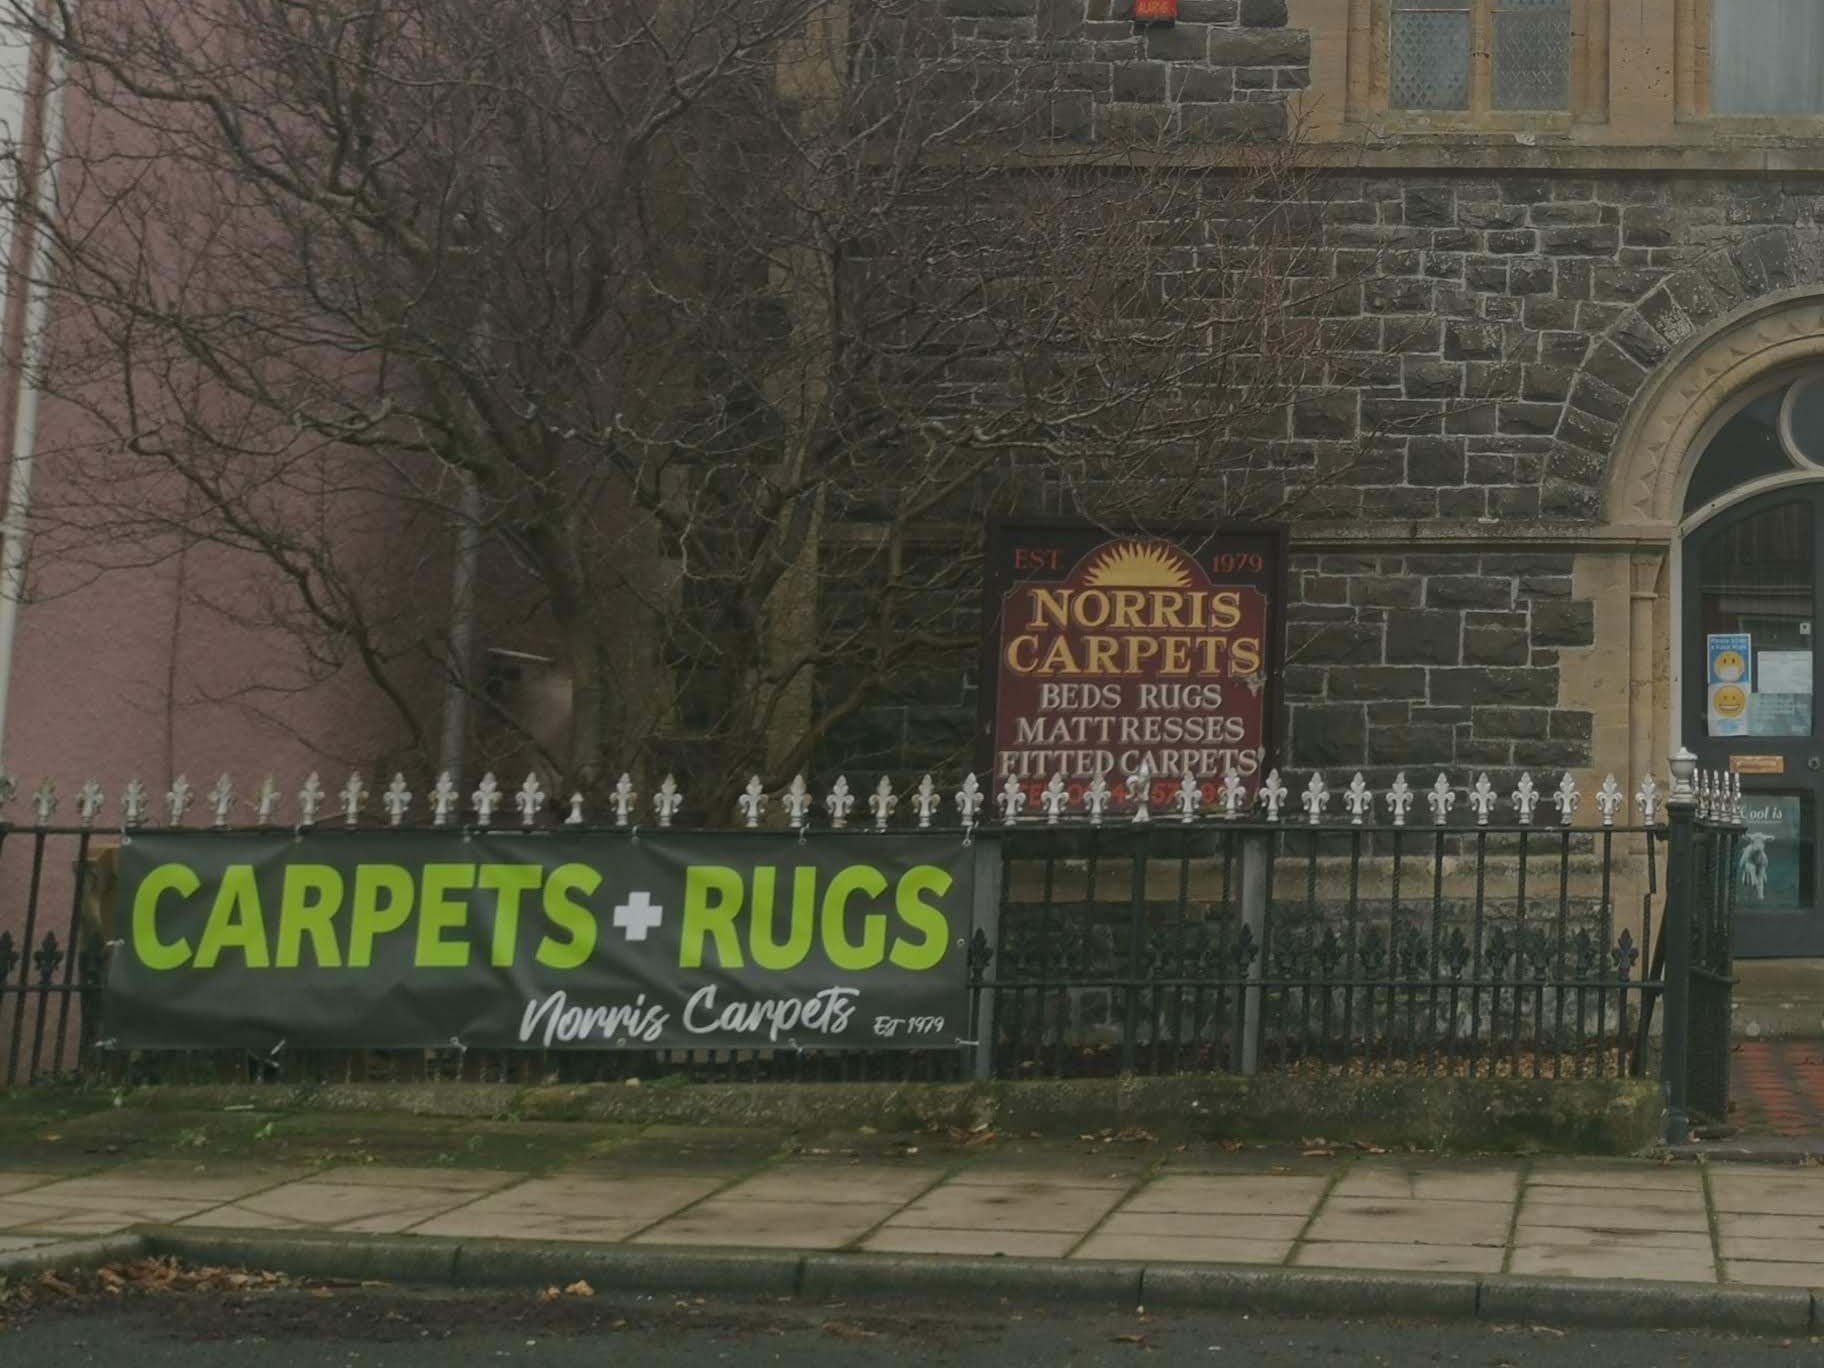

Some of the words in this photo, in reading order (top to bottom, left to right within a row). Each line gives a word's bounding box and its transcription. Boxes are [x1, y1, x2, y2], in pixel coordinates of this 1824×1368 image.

[1212, 553, 1264, 574] 1979
[1026, 588, 1241, 631] NORRIS
[1006, 635, 1263, 676] CARPETS
[1040, 683, 1122, 712] BEDS
[1138, 684, 1223, 711] RUGS
[1016, 717, 1246, 746] MATTRESSES
[999, 750, 1114, 778] FITTED
[1120, 749, 1259, 777] CARPETS
[131, 863, 602, 970] CARPETS
[680, 865, 954, 970] RUGS
[519, 989, 671, 1047] Norris
[683, 983, 861, 1041] Carpets
[907, 1015, 945, 1035] 1979
